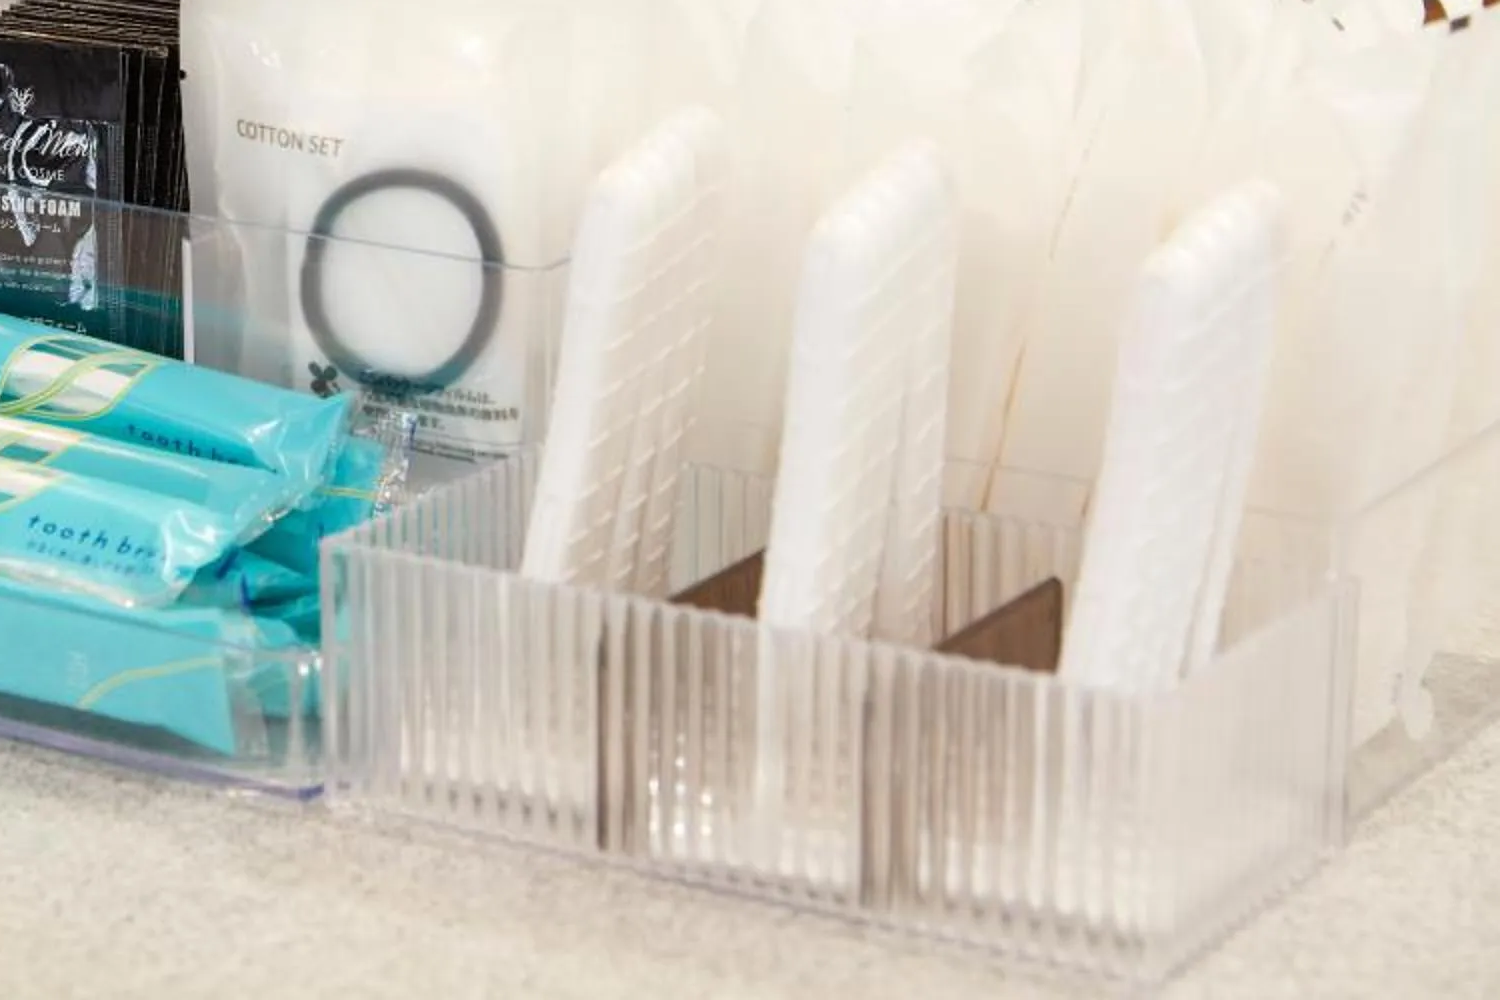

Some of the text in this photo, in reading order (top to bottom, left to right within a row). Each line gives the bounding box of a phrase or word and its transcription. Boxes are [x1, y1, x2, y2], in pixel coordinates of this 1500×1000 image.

[237, 118, 344, 157] COTTON SET
[40, 198, 81, 217] FOAM
[128, 423, 200, 457] tooth
[28, 514, 109, 549] tooth
